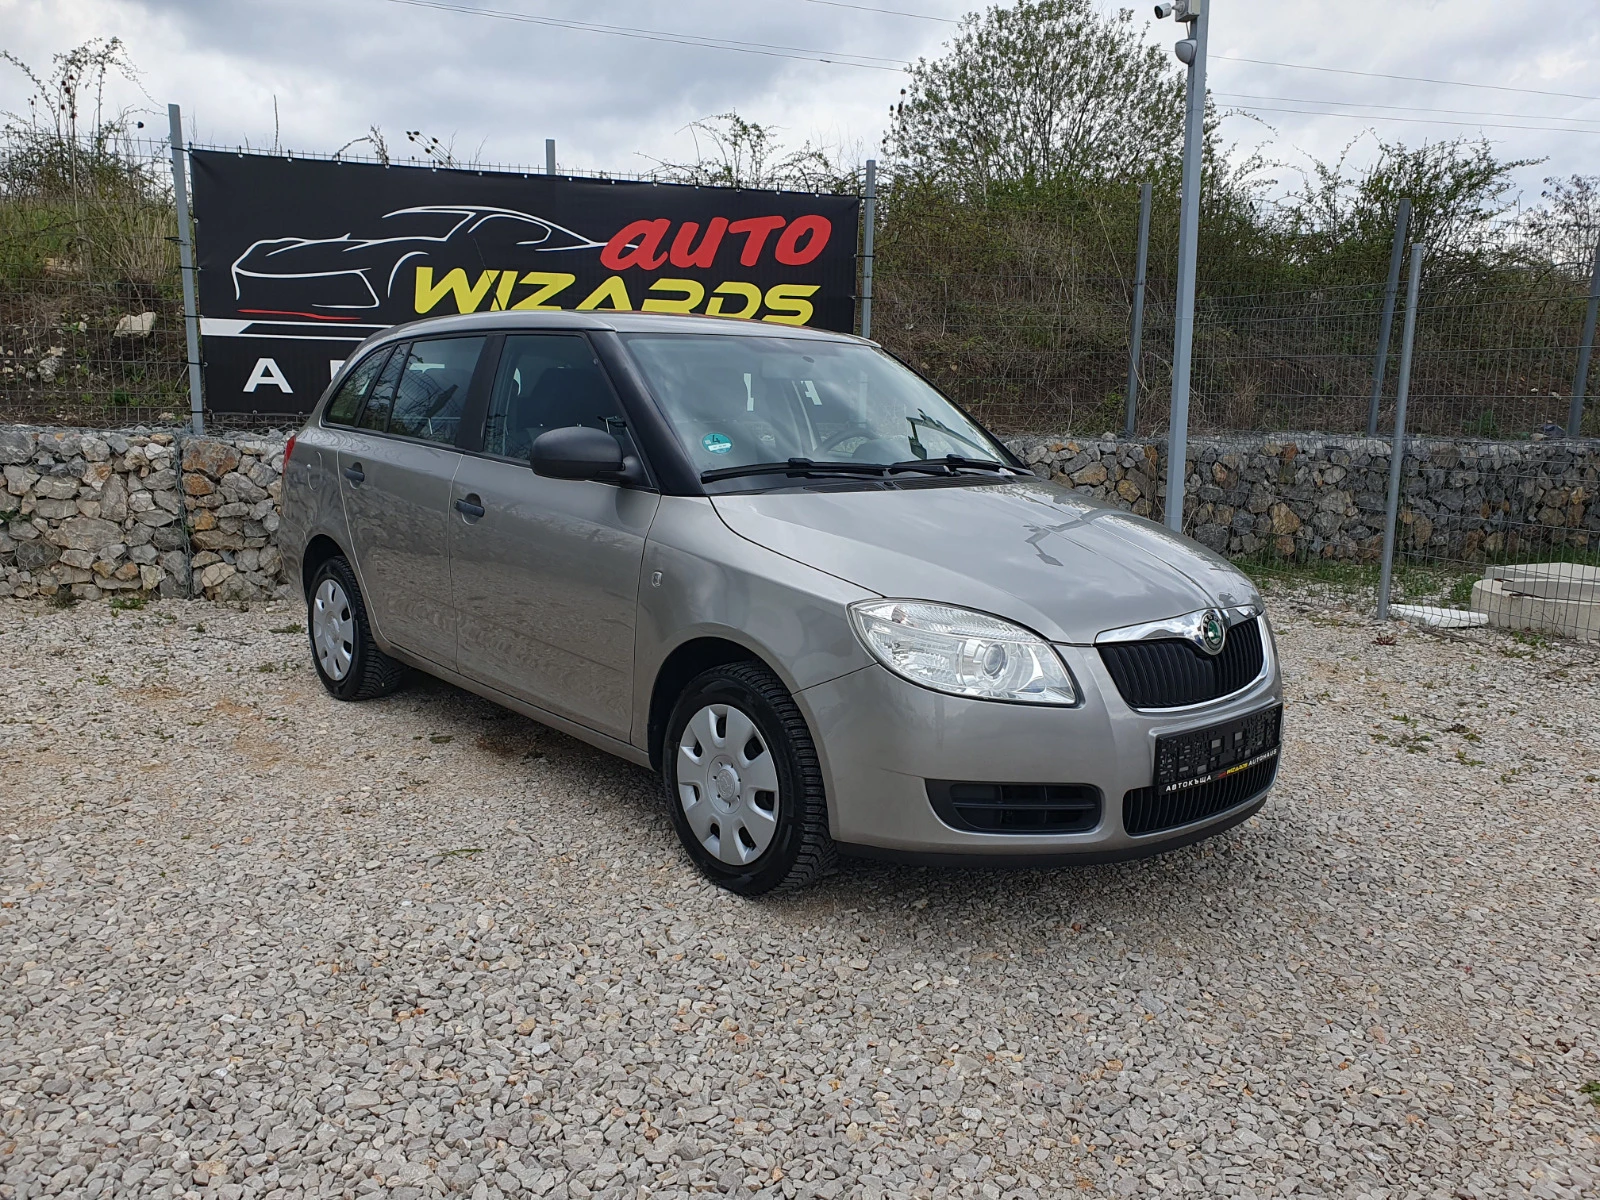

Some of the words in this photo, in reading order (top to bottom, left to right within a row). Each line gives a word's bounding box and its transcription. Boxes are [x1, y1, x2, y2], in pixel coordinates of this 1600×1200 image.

[414, 266, 821, 326] WIZARDS
[1248, 748, 1278, 767] AUTOHAUS
[1165, 774, 1212, 792] АВТОКЪЩА
